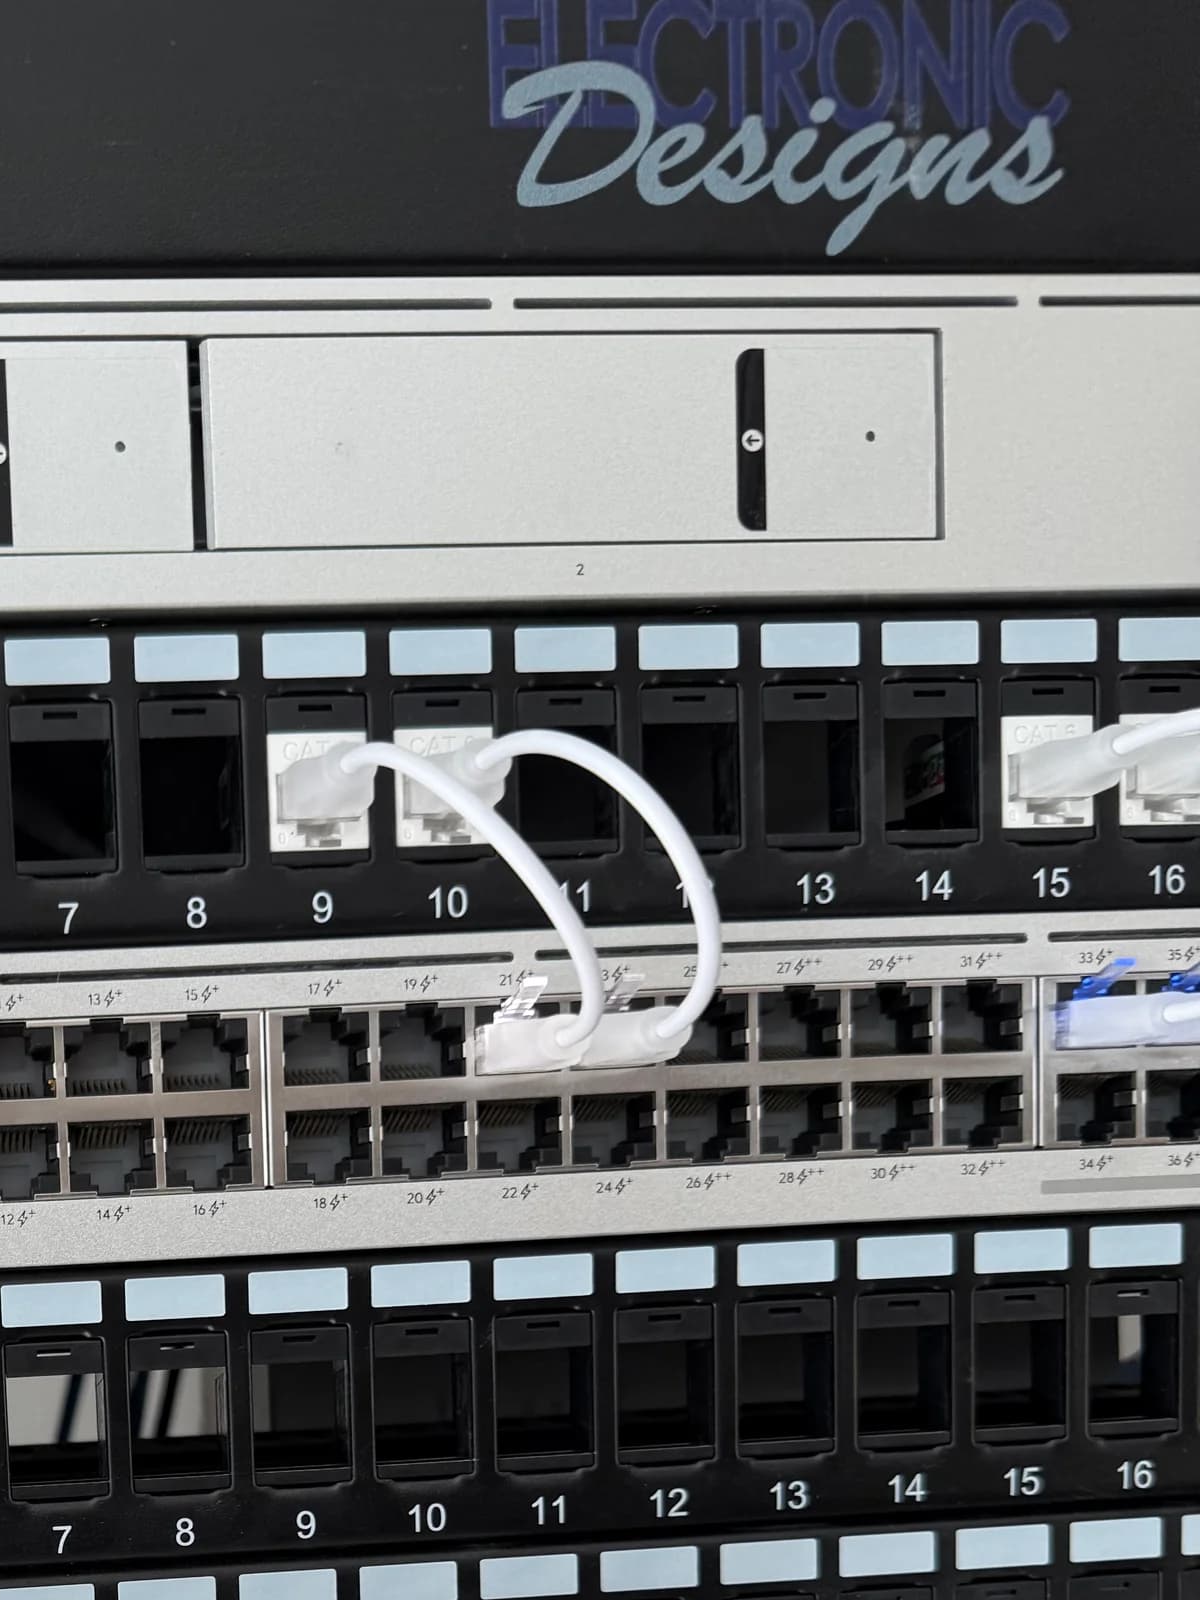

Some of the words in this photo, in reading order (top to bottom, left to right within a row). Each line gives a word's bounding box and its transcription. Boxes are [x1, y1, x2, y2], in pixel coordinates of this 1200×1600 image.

[488, 0, 1072, 129] ELECTRONIC
[501, 59, 1064, 258] Designs
[796, 873, 835, 905] 13
[915, 870, 953, 901] 14
[1032, 867, 1070, 898] 15
[1148, 864, 1186, 895] 16
[186, 896, 207, 929] 8
[311, 891, 333, 923] 9
[428, 885, 468, 919] 10
[57, 901, 79, 935] 7
[888, 1473, 926, 1503] 14
[1003, 1466, 1041, 1497] 15
[1117, 1459, 1153, 1489] 16
[531, 1495, 565, 1525] 11
[649, 1487, 689, 1518] 12
[769, 1480, 808, 1511] 13
[175, 1517, 195, 1547] 8
[296, 1510, 316, 1539] 9
[408, 1502, 447, 1533] 10
[52, 1525, 73, 1554] 7
